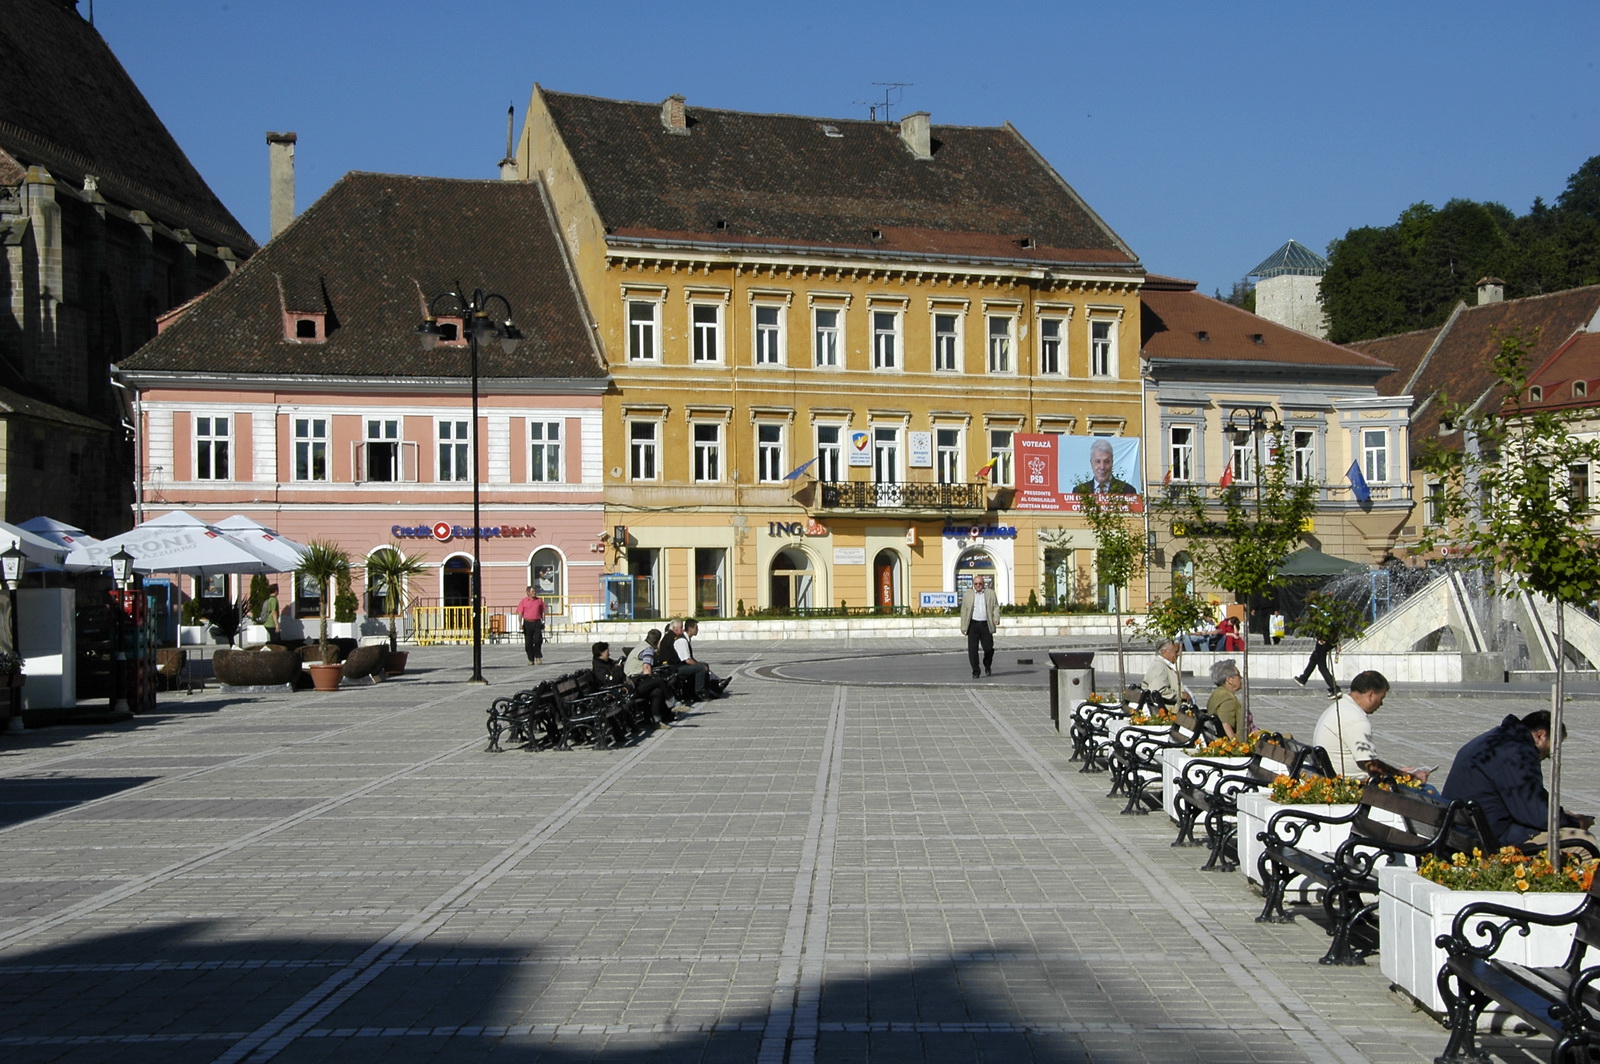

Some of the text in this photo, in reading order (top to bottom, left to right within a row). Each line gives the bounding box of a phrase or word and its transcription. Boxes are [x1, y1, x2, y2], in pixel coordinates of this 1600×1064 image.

[1030, 475, 1044, 484] PSD
[392, 525, 433, 539] Credit
[501, 525, 536, 538] Bank
[768, 521, 804, 537] ING
[142, 544, 197, 560] AZZURRO
